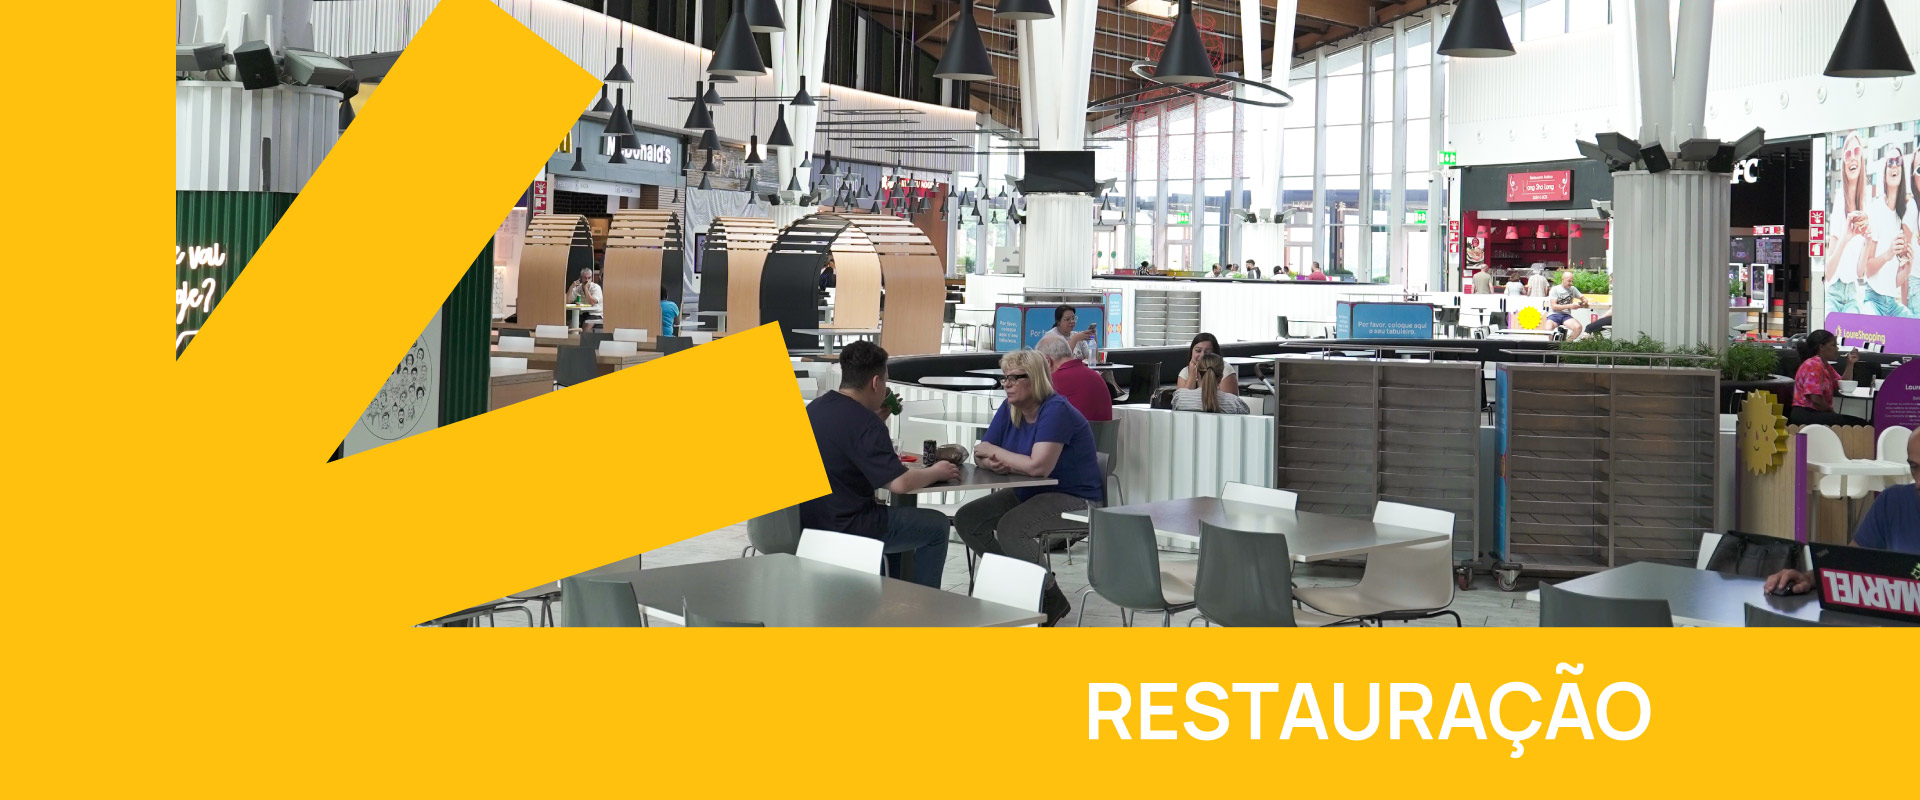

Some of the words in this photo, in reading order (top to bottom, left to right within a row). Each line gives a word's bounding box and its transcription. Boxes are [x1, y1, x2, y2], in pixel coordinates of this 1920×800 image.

[606, 135, 672, 165] MDonald's
[1730, 158, 1759, 184] FC
[1369, 321, 1387, 329] favor,
[1388, 322, 1413, 330] coloque
[1843, 328, 1885, 345] LoureShopping
[1823, 570, 1920, 612] MARVEL
